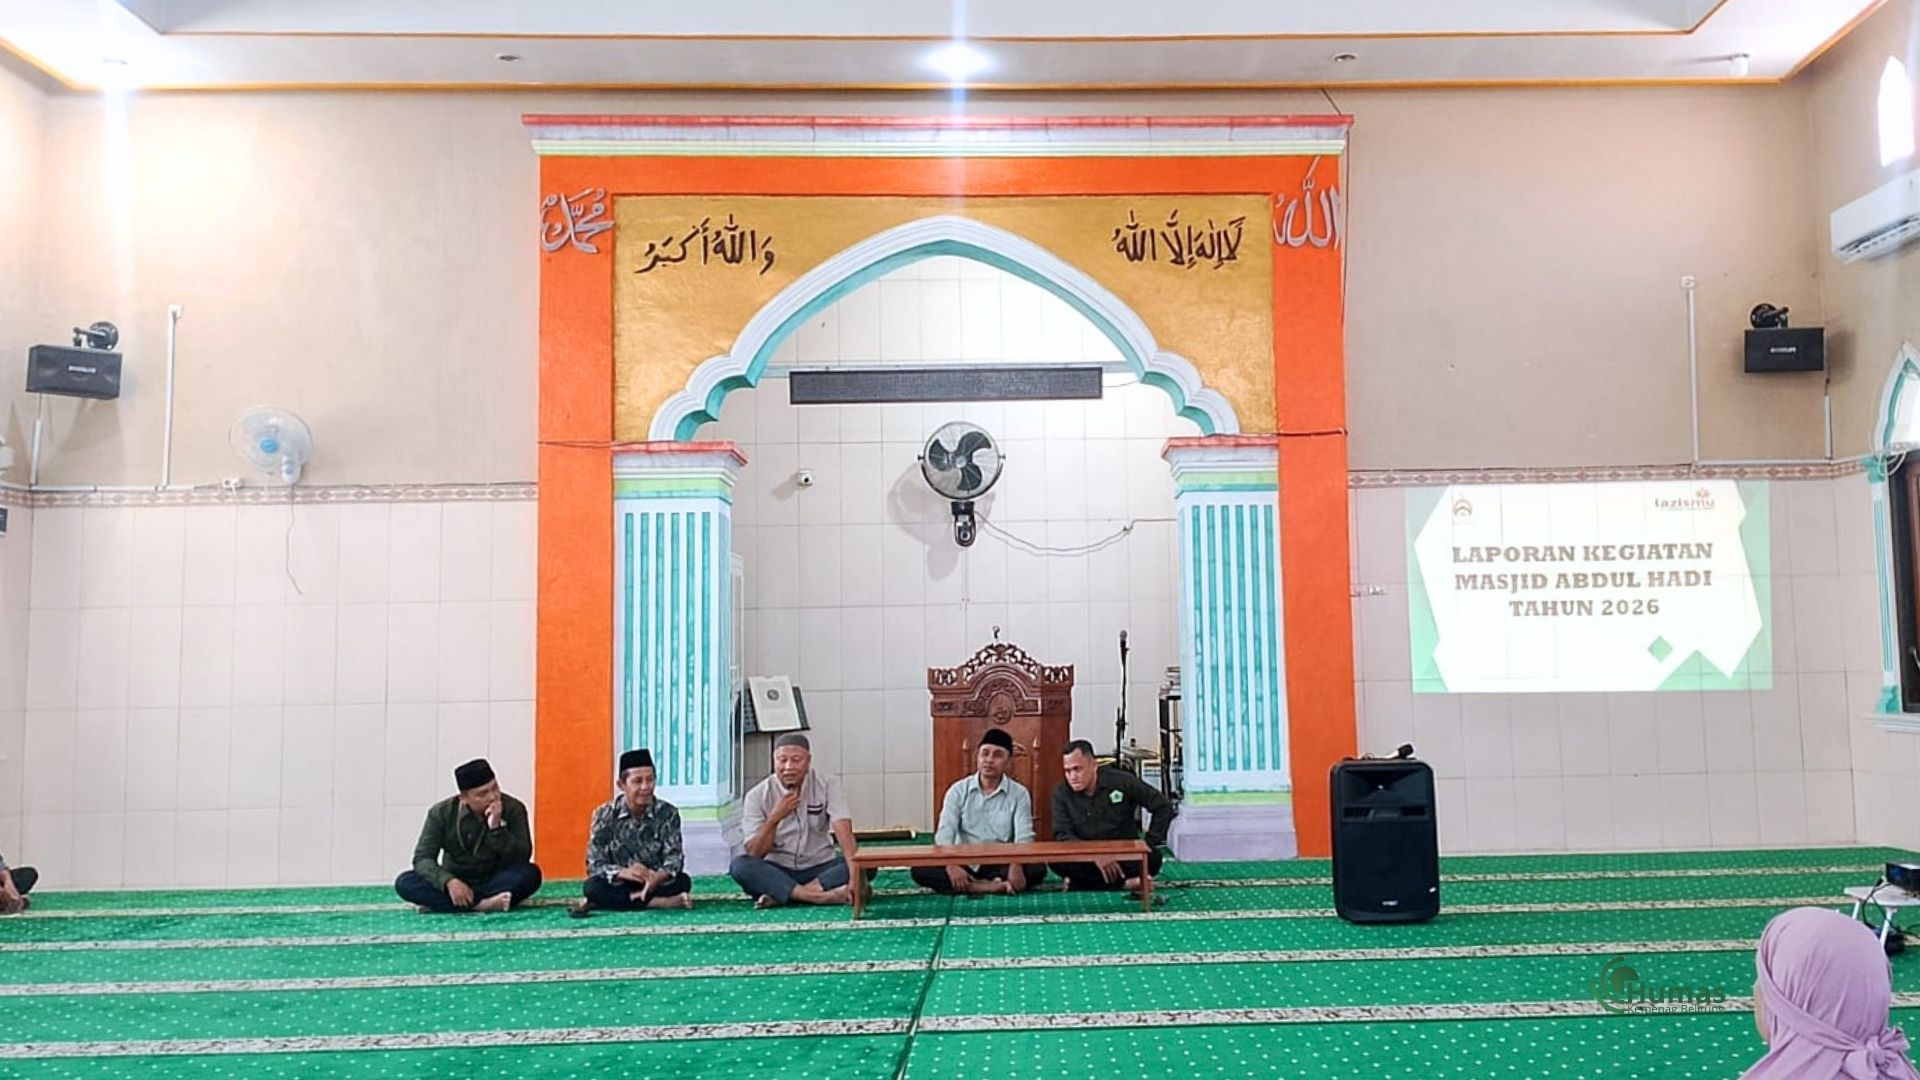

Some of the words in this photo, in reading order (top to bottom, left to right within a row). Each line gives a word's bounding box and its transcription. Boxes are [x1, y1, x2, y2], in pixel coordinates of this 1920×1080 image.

[1452, 545, 1576, 563] LAPORAN
[1582, 543, 1714, 561] KEGIATAN
[1455, 573, 1549, 594] MASJID
[1555, 571, 1642, 589] ABDUL
[1647, 569, 1713, 588] HADI
[1508, 600, 1594, 617] TAHUN
[1601, 598, 1661, 616] 2026
